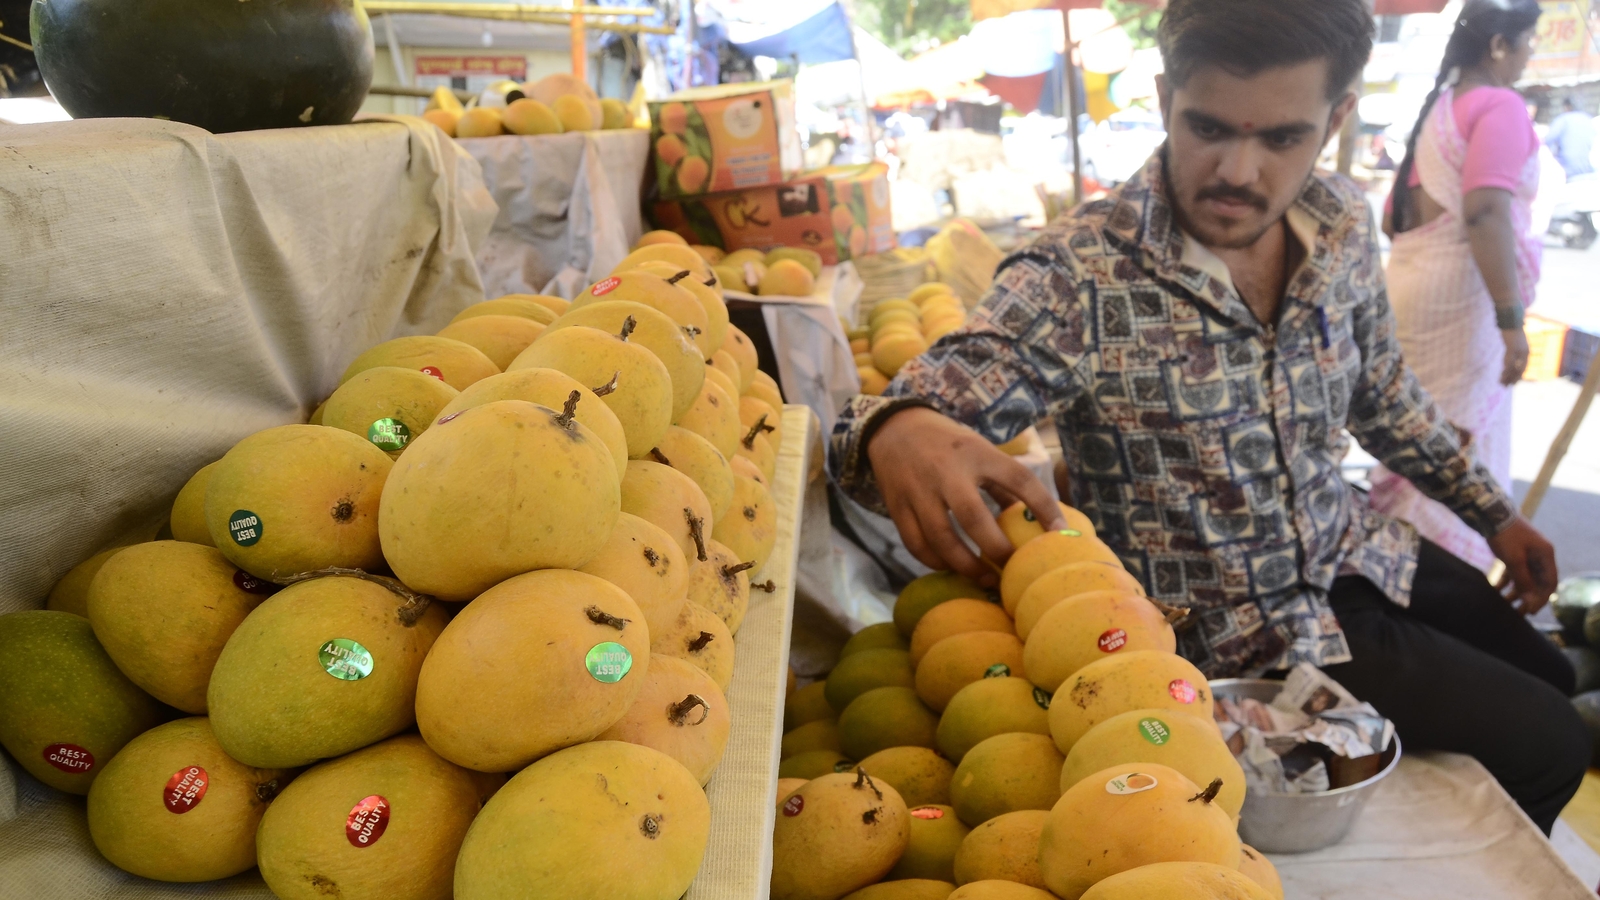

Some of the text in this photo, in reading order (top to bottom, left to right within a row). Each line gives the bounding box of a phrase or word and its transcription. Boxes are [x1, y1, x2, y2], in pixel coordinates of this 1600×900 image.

[379, 425, 402, 433] BEST
[372, 434, 408, 443] QUALITY
[230, 516, 258, 531] QUALITY
[237, 528, 256, 541] BEST
[324, 643, 369, 667] QUALITY
[590, 652, 627, 662] QUALITY
[327, 657, 357, 676] BEST
[596, 664, 621, 675] BEST
[1141, 721, 1163, 744] QUALITY
[1151, 721, 1168, 737] BEST
[60, 748, 87, 759] BEST
[50, 754, 91, 770] QUALITY
[169, 767, 199, 806] QUALITY
[182, 778, 205, 806] BEST
[350, 802, 371, 831] BEST
[358, 800, 387, 844] QUALITY
